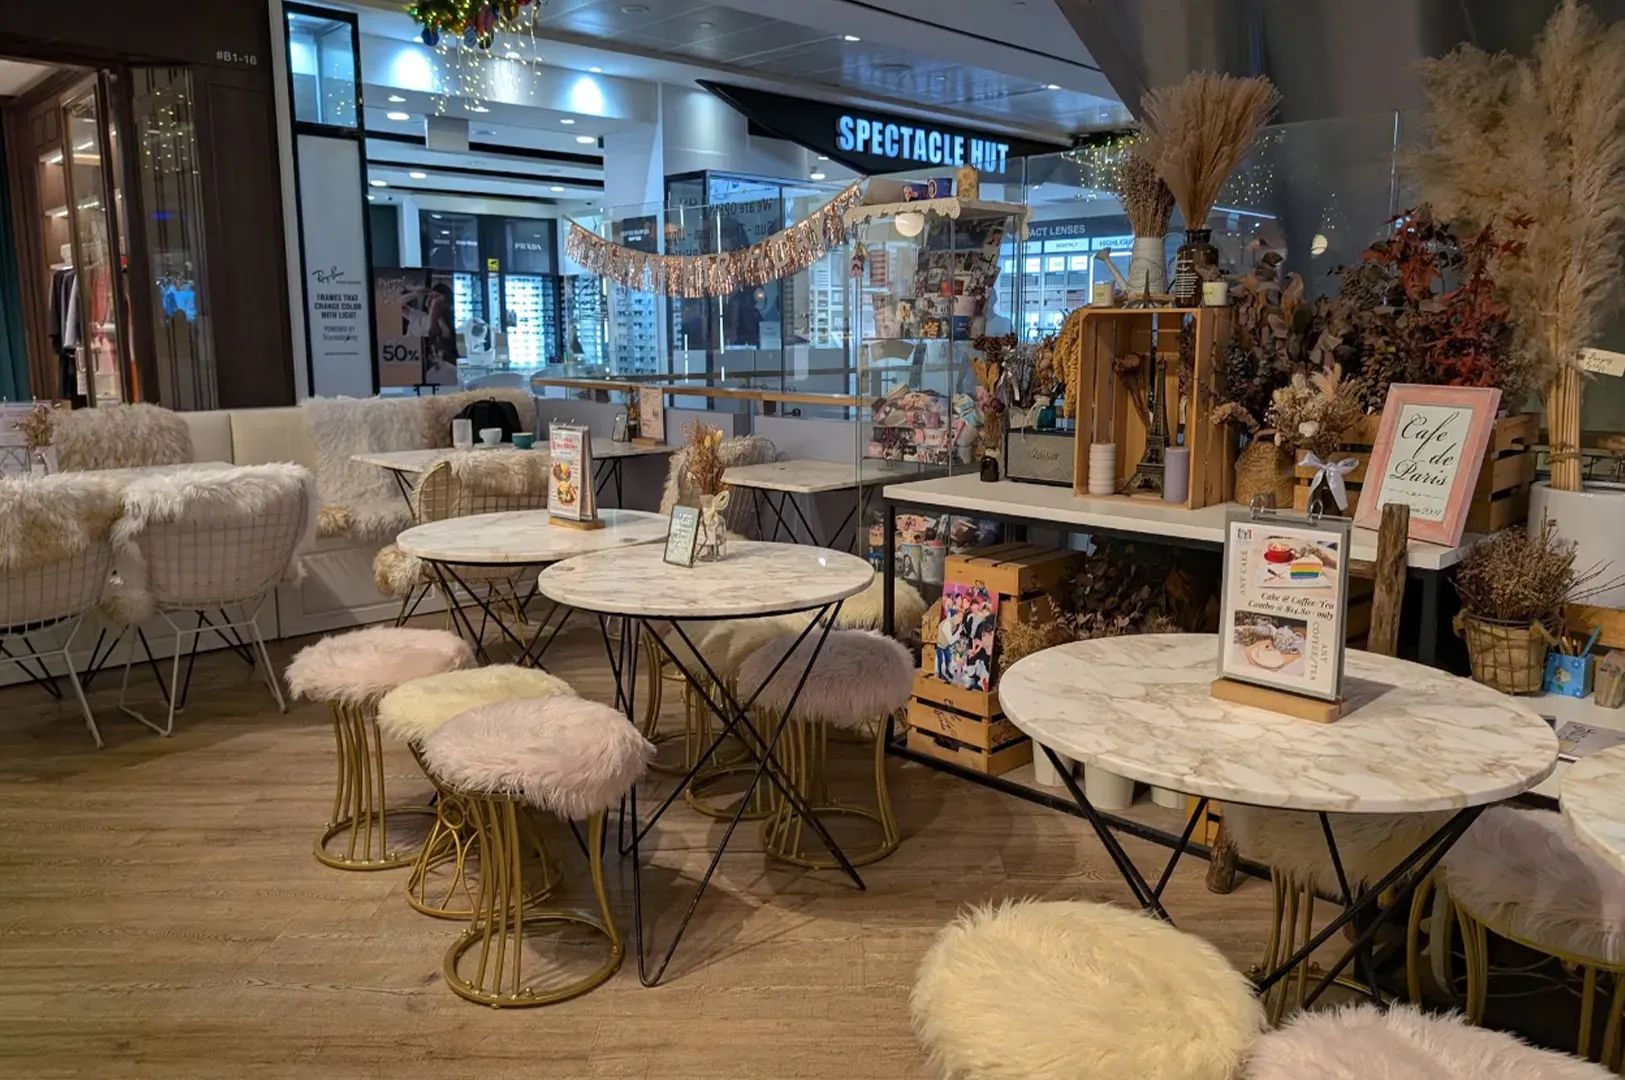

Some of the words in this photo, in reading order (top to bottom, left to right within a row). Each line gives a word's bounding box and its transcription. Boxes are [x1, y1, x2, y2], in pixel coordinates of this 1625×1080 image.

[216, 50, 257, 65] #B1-16
[837, 115, 965, 168] SPECTACLE
[969, 138, 1009, 174] HUT
[1049, 224, 1086, 236] LENSES
[514, 241, 543, 251] PRADA
[317, 293, 342, 302] FRAMES
[343, 294, 358, 302] THAT
[314, 302, 340, 310] CHANGE
[321, 311, 337, 319] WITH
[338, 311, 357, 319] LIGHT
[383, 344, 420, 361] 50%
[1429, 443, 1457, 466] de
[1389, 459, 1448, 486] Paris
[1261, 592, 1280, 601] Cake
[1248, 600, 1275, 610] Combo
